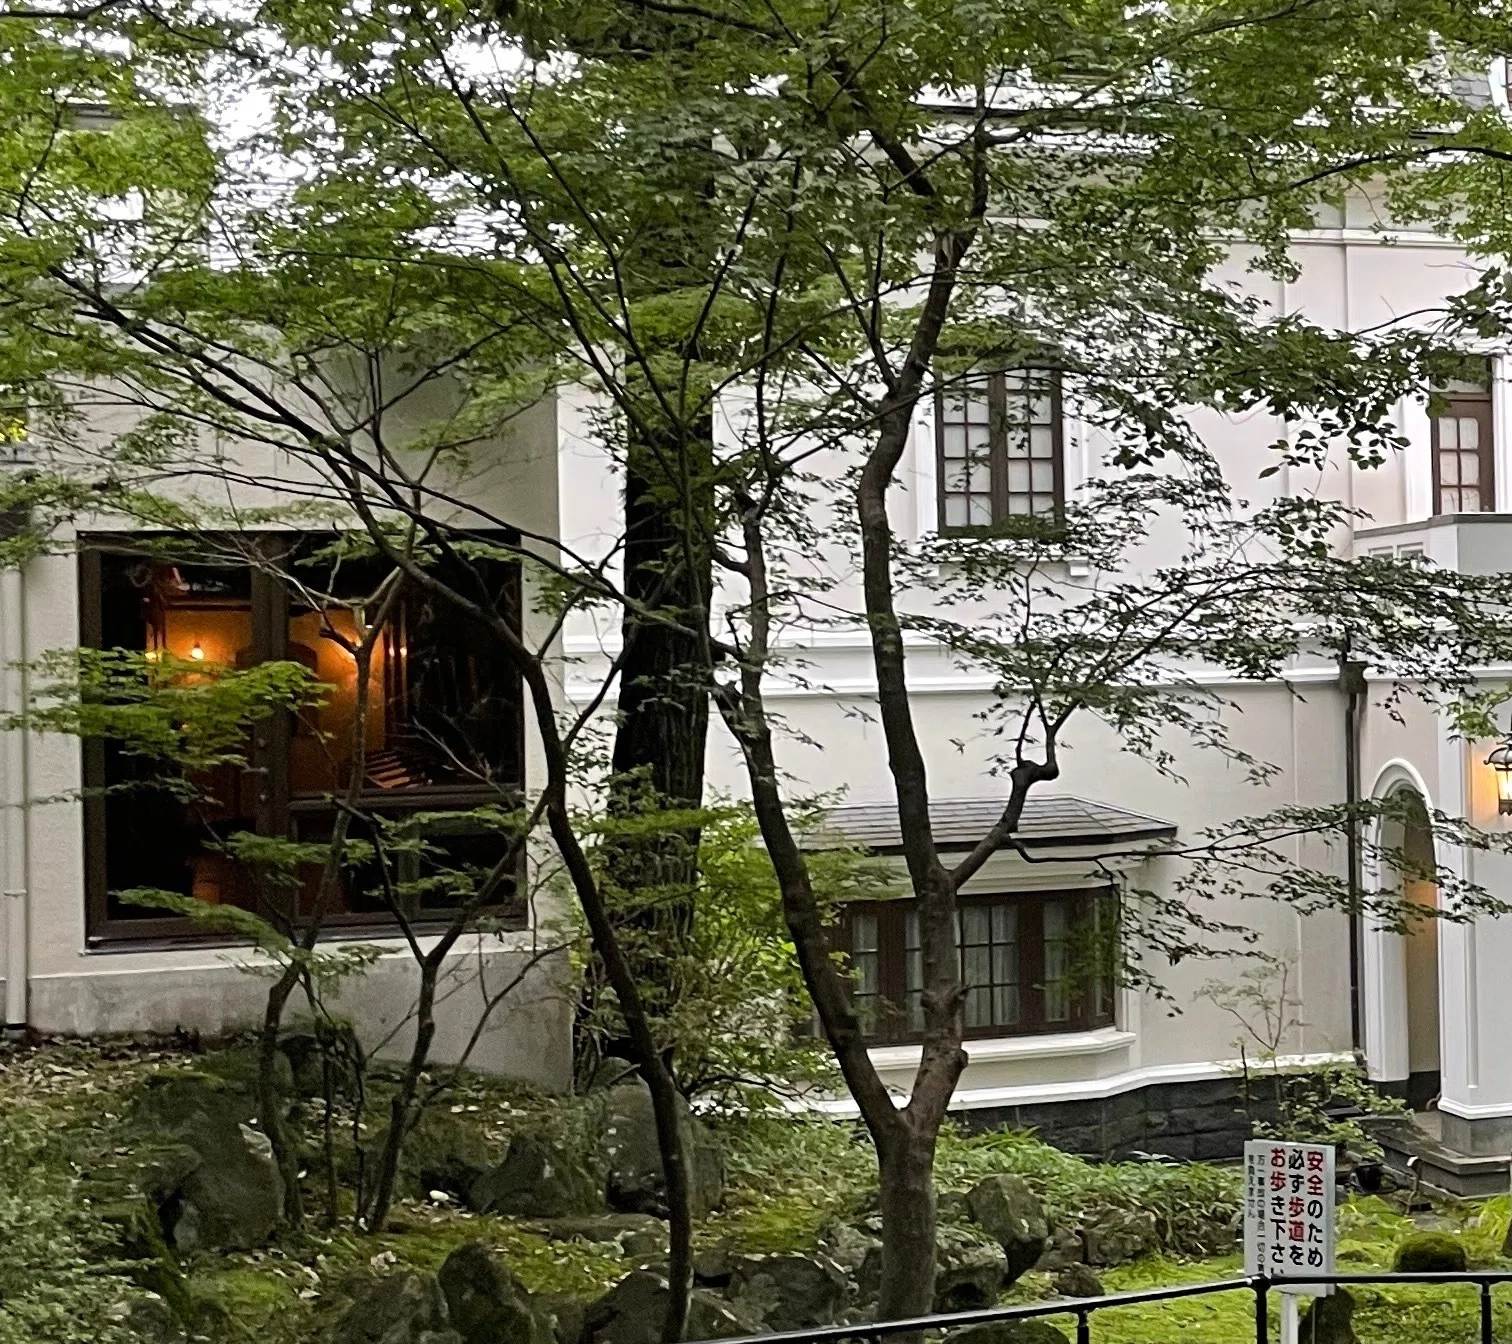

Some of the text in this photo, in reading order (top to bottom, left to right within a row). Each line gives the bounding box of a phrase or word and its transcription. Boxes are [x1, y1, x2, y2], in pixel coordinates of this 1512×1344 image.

[1270, 1147, 1287, 1275] お歩き下さい
[1288, 1148, 1305, 1266] 必ず歩道を
[1307, 1150, 1324, 1268] 安全のため
